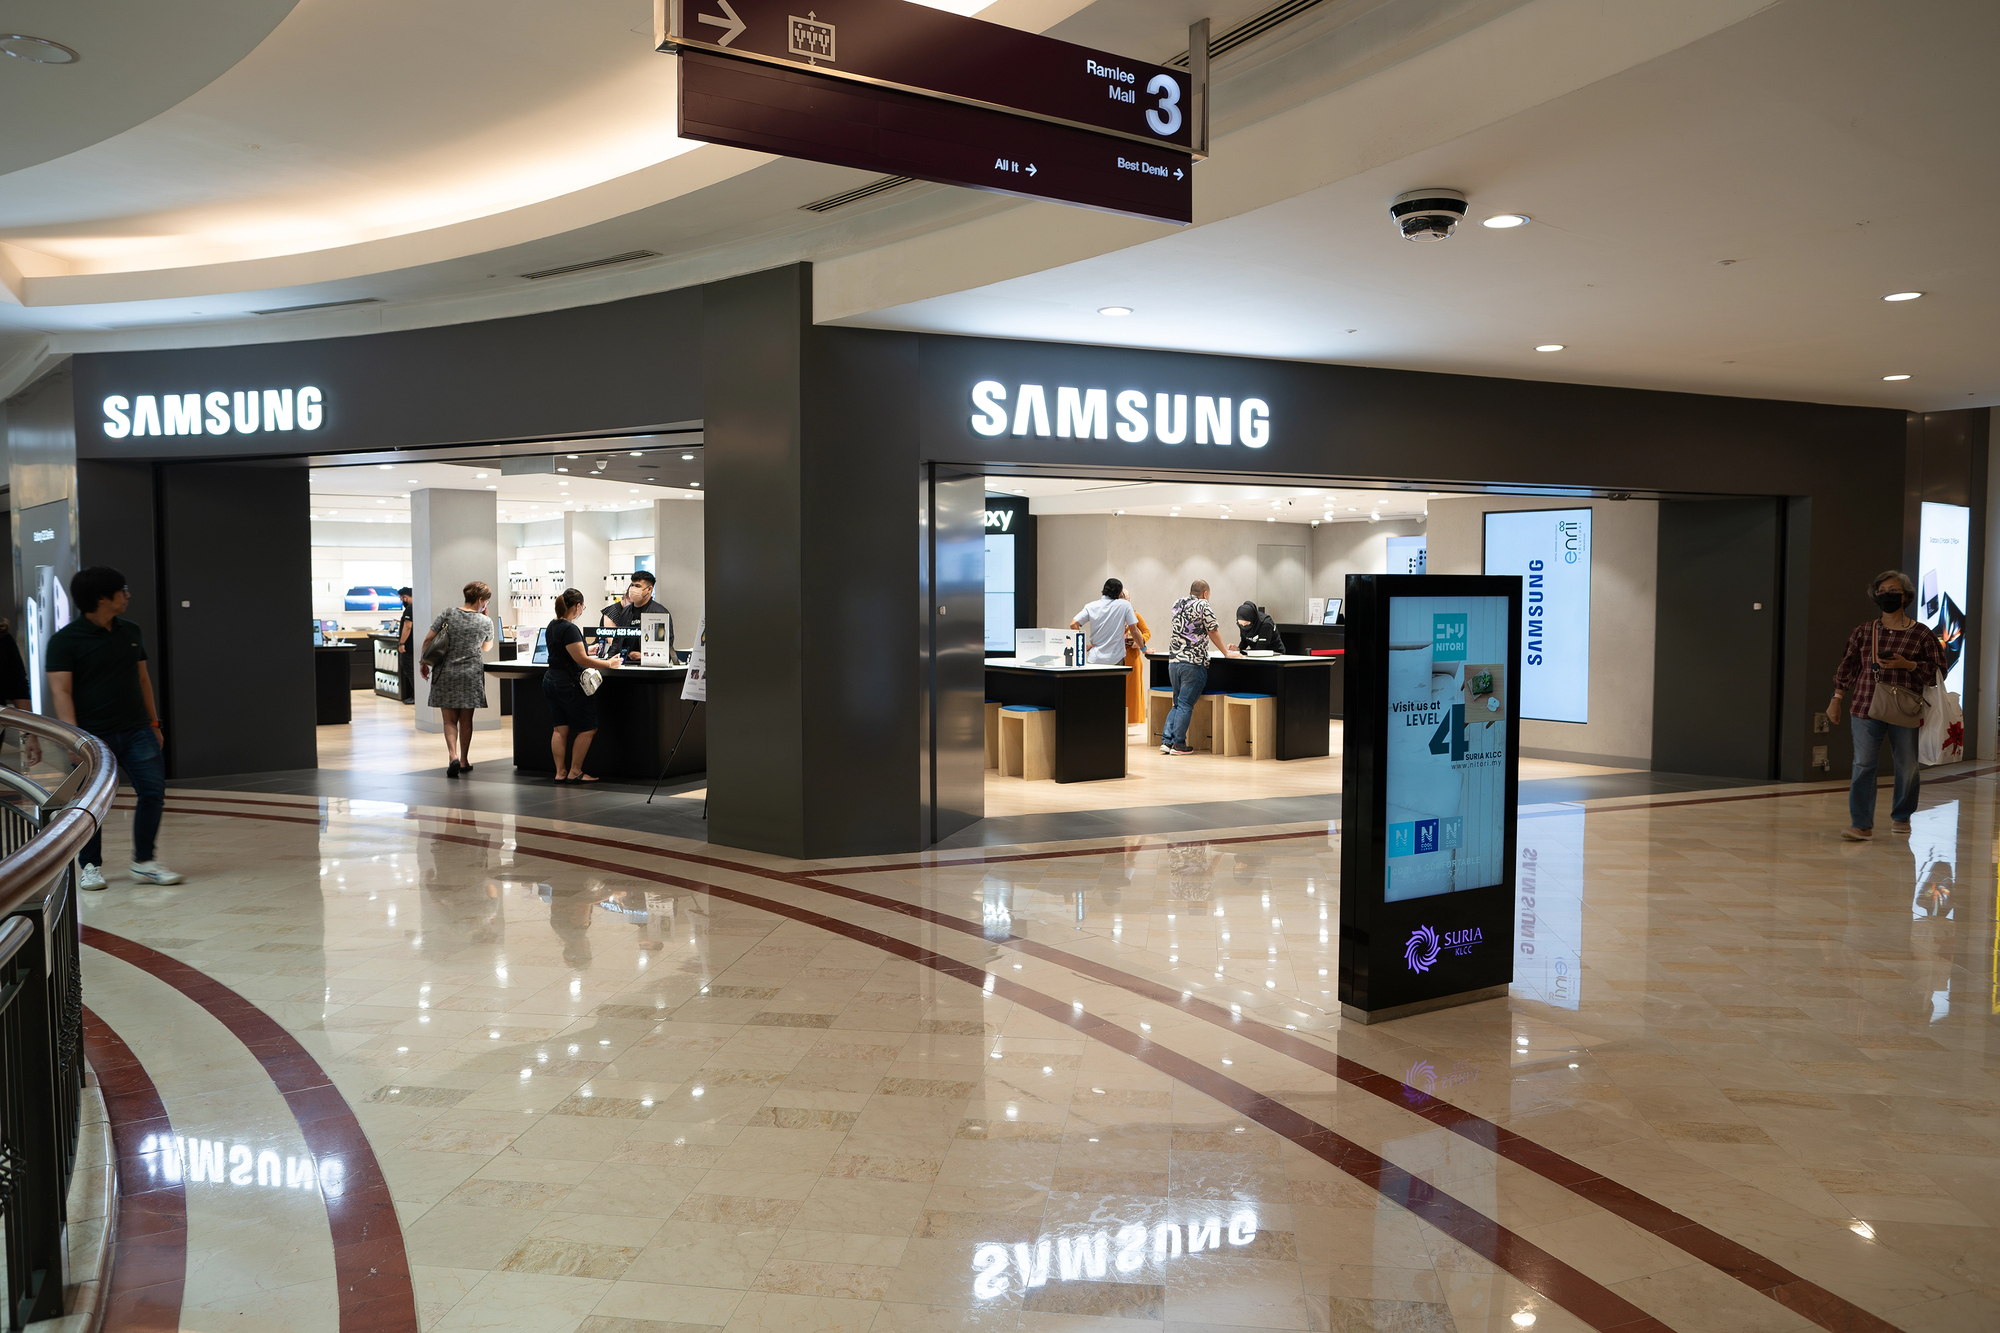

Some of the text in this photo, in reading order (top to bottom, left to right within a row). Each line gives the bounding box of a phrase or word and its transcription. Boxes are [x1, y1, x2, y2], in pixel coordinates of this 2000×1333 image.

[1086, 59, 1135, 84] Ramlee
[1109, 84, 1135, 104] Mall
[1145, 73, 1182, 136] 3
[994, 158, 1020, 173] All It
[1117, 157, 1169, 178] Best Denki
[102, 385, 324, 439] SAMSUNG
[970, 380, 1270, 448] SAMSUNG
[1527, 559, 1544, 666] SAMSUNG
[596, 628, 617, 637] Galaxy
[617, 628, 627, 636] S23
[1436, 623, 1464, 639] ニトリ
[1436, 642, 1464, 651] NITORI
[1393, 700, 1440, 712] Visit us at
[1406, 712, 1440, 726] LEVEL
[1428, 703, 1469, 761] 4
[1465, 751, 1502, 761] SURIA KLCC
[1451, 760, 1502, 769] www.nitori.my
[1424, 856, 1481, 871] COMFORTABLE
[1444, 926, 1483, 946] SURIA
[1455, 945, 1472, 956] KLCC
